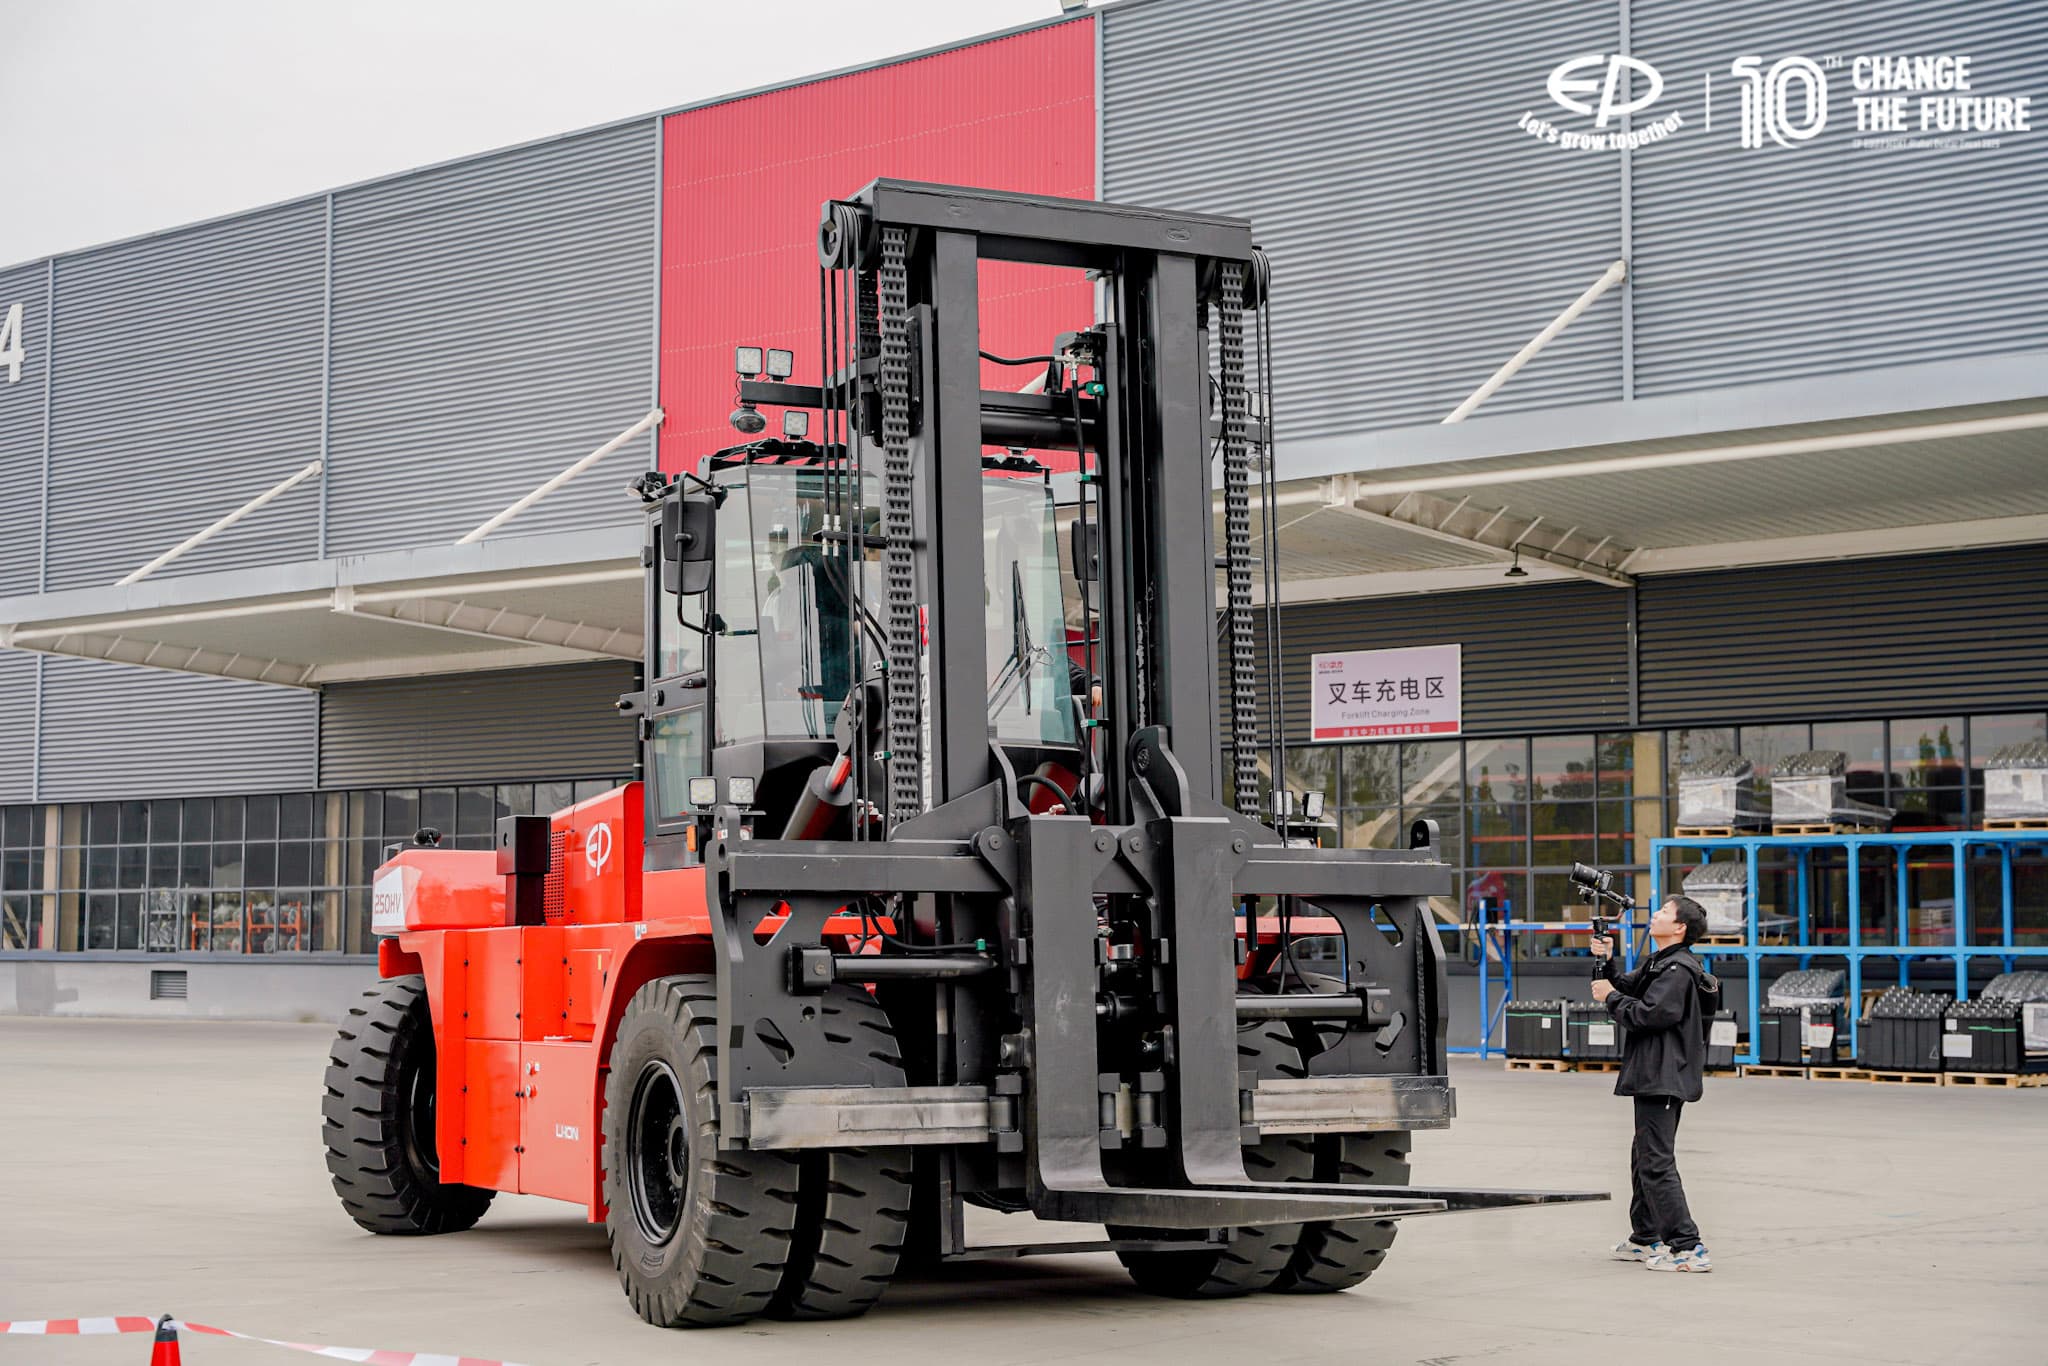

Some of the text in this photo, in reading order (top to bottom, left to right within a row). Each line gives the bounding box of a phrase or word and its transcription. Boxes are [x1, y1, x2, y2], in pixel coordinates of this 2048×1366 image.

[0, 317, 25, 394] 4
[1328, 676, 1445, 705] 叉车充电区
[1341, 707, 1430, 720] Forklift Charging Zone
[374, 892, 402, 914] 250HV
